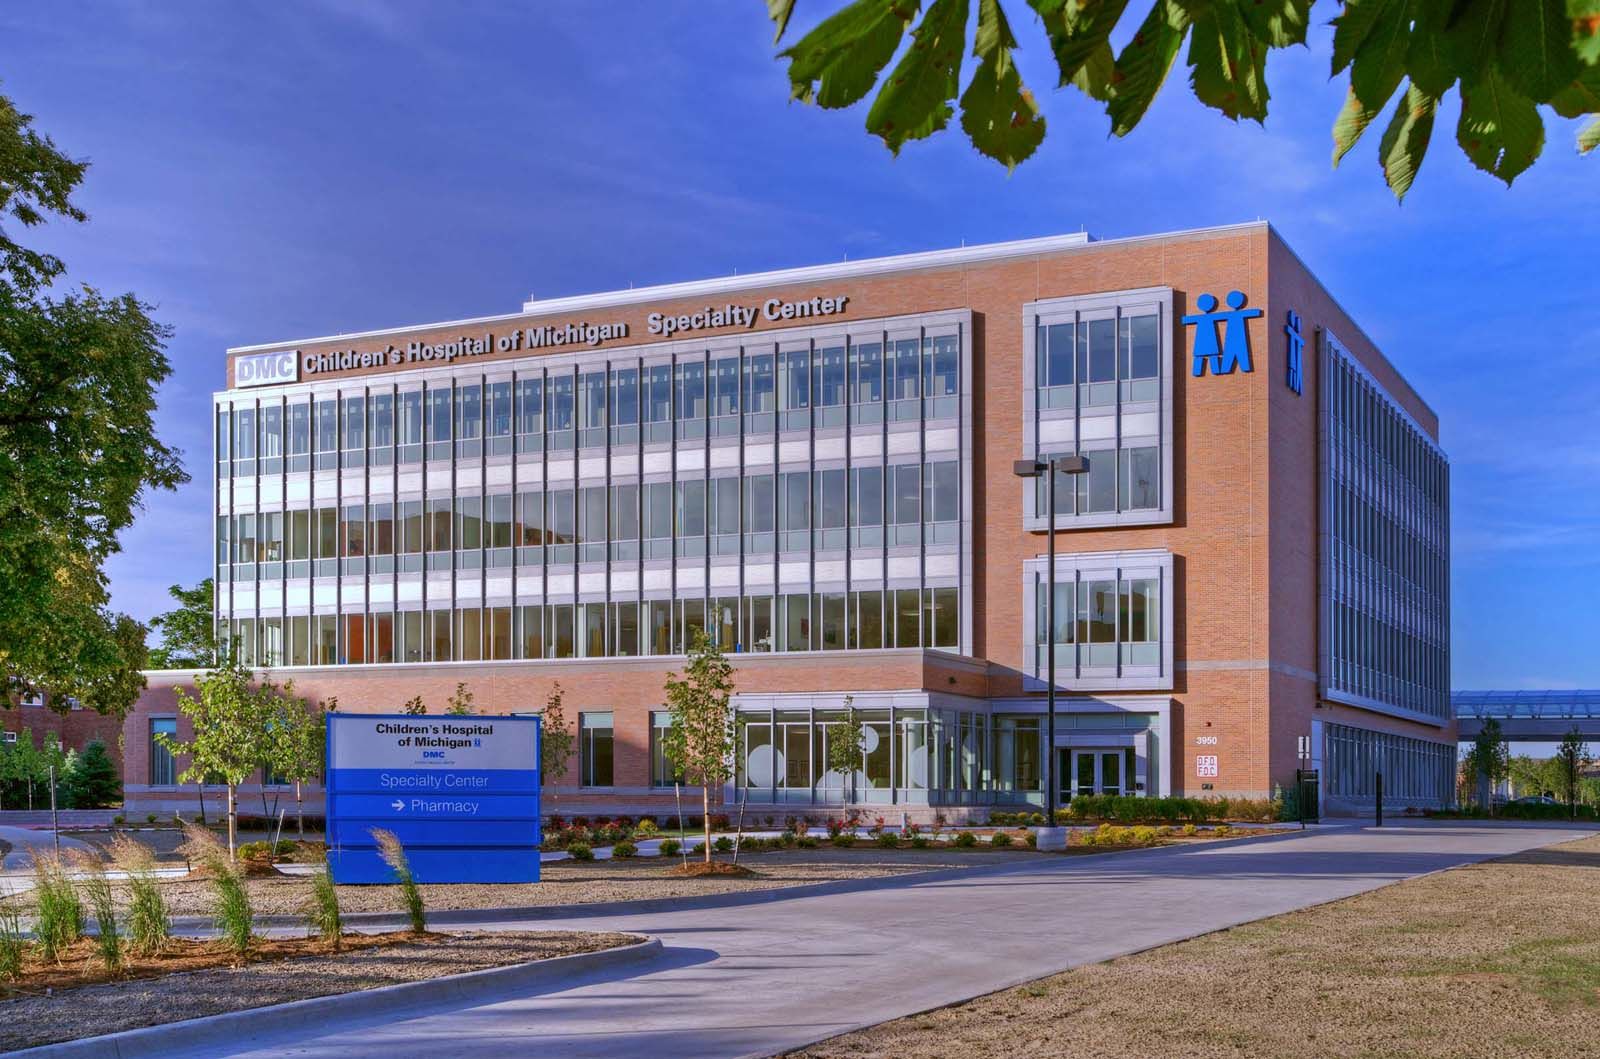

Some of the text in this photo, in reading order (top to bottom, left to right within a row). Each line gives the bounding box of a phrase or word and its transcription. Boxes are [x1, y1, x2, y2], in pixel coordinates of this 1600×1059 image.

[303, 296, 848, 374] Children's Hospital of Michigan Specialty Center
[239, 355, 293, 381] DMC
[376, 723, 494, 736] Children's Hospital
[398, 737, 472, 748] of Michigan
[1196, 736, 1217, 745] 3950
[380, 773, 489, 788] Specialty Center
[411, 799, 479, 814] Pharmacy
